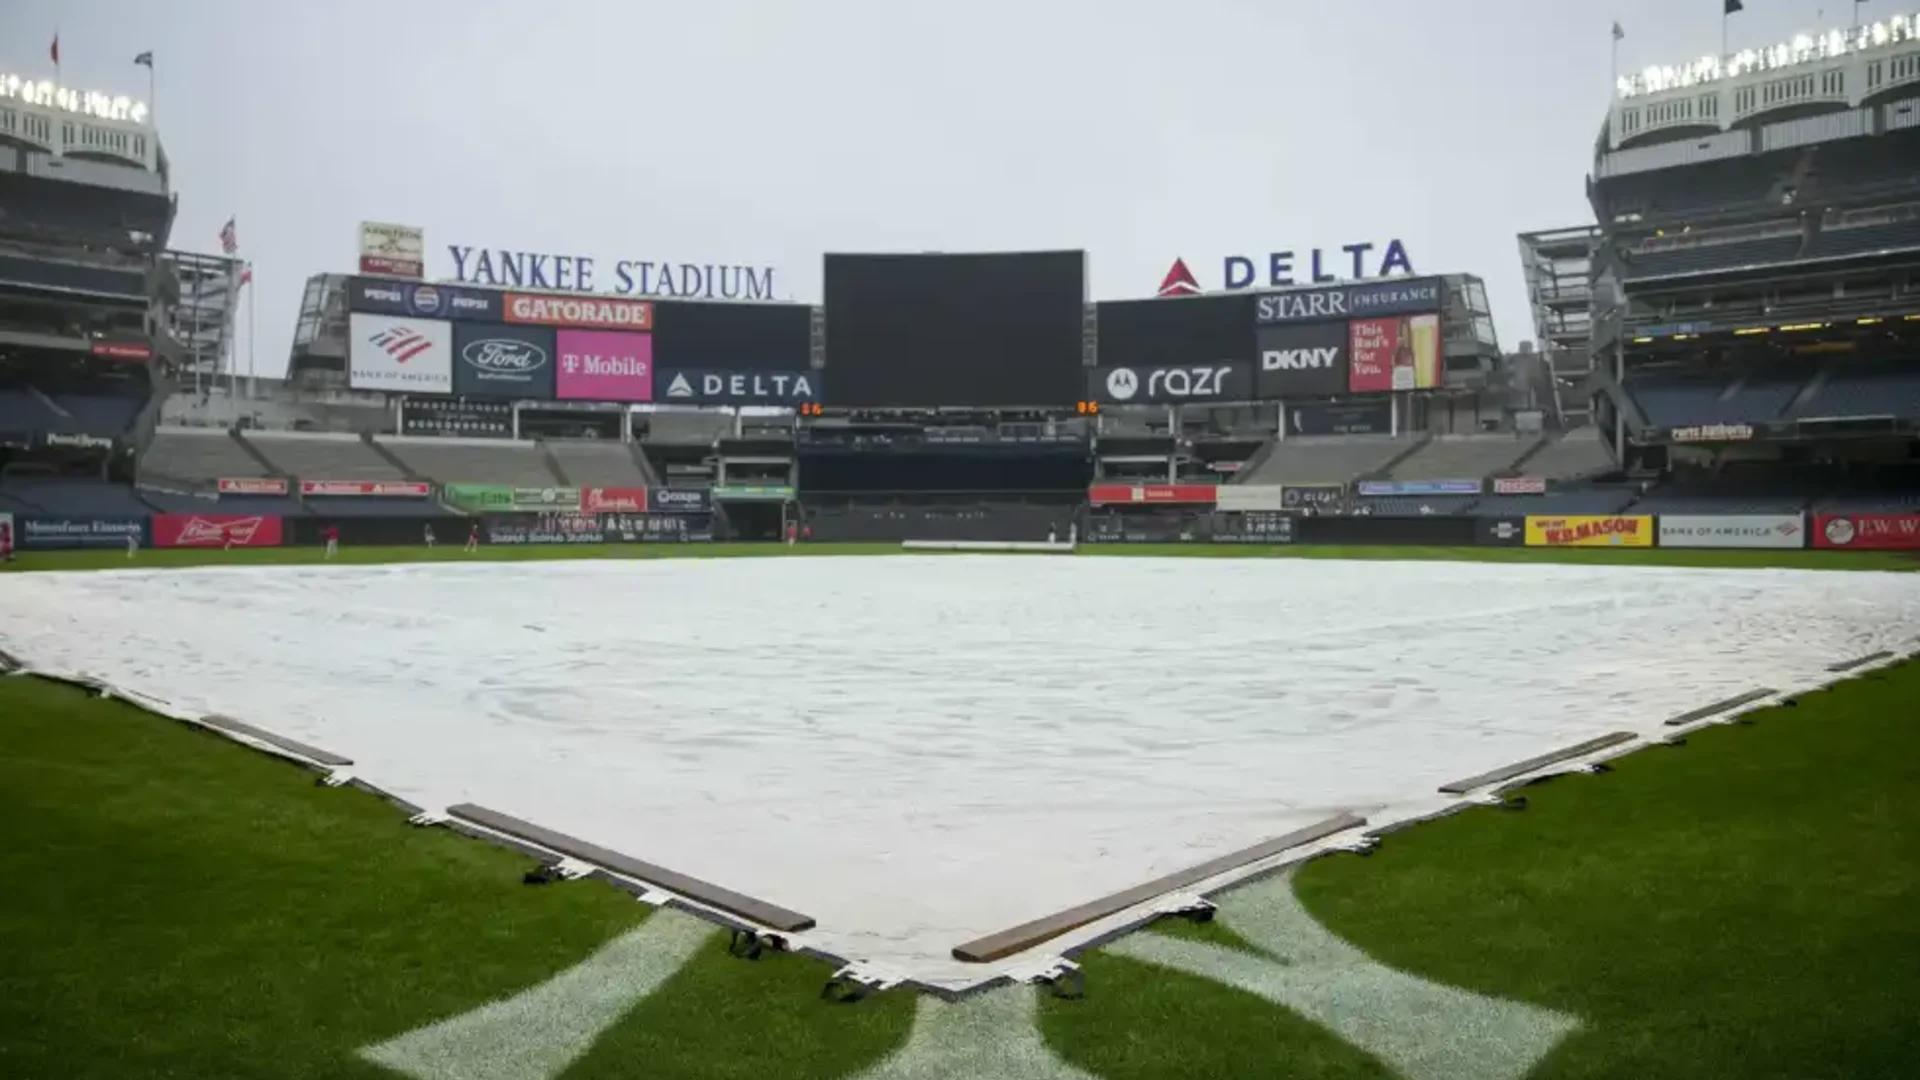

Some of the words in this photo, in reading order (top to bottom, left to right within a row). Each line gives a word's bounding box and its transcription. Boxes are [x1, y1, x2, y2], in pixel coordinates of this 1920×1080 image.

[447, 246, 594, 293] YANKEE
[614, 261, 775, 299] STADIUM
[1224, 239, 1413, 289] DELTA
[452, 297, 489, 309] PEPSI
[512, 297, 646, 324] GATORADE
[1257, 290, 1347, 320] STARR
[1354, 287, 1437, 306] INSURANCE
[1353, 323, 1384, 336] This
[1353, 336, 1389, 349] Bud's
[477, 345, 531, 368] Ford
[583, 354, 647, 377] Mobile
[1262, 347, 1339, 371] DKNY
[1353, 363, 1382, 375] You.
[703, 374, 812, 397] DELTA
[1148, 367, 1232, 396] razr
[1662, 527, 1696, 536] BANK
[1696, 527, 1712, 536] OF
[1715, 526, 1771, 537] AMERICA
